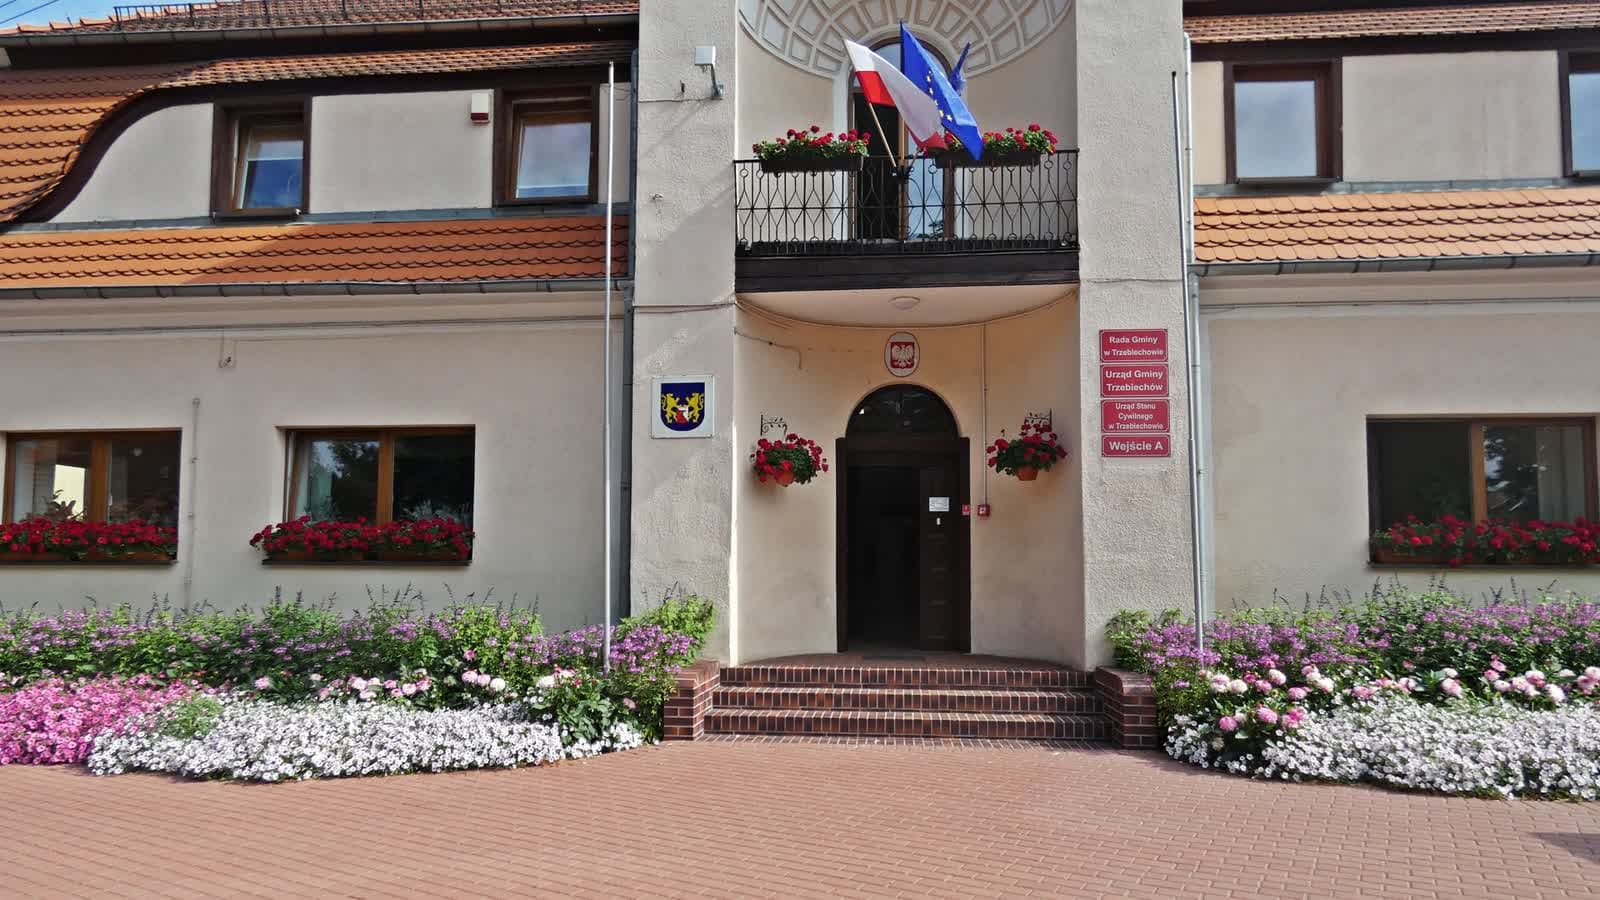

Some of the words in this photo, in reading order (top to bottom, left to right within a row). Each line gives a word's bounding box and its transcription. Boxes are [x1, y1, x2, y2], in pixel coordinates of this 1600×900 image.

[1109, 336, 1130, 344] Rada
[1131, 336, 1158, 345] Gminy
[1111, 348, 1164, 356] Trzebiechowie
[1105, 370, 1132, 380] Urząd
[1134, 370, 1163, 379] Gminy
[1106, 383, 1163, 391] Trzebiechów
[1115, 403, 1135, 411] Urząd
[1136, 402, 1156, 410] Stanu
[1118, 412, 1153, 421] Cywilnego
[1109, 441, 1152, 453] Wejście
[1154, 441, 1163, 450] A
